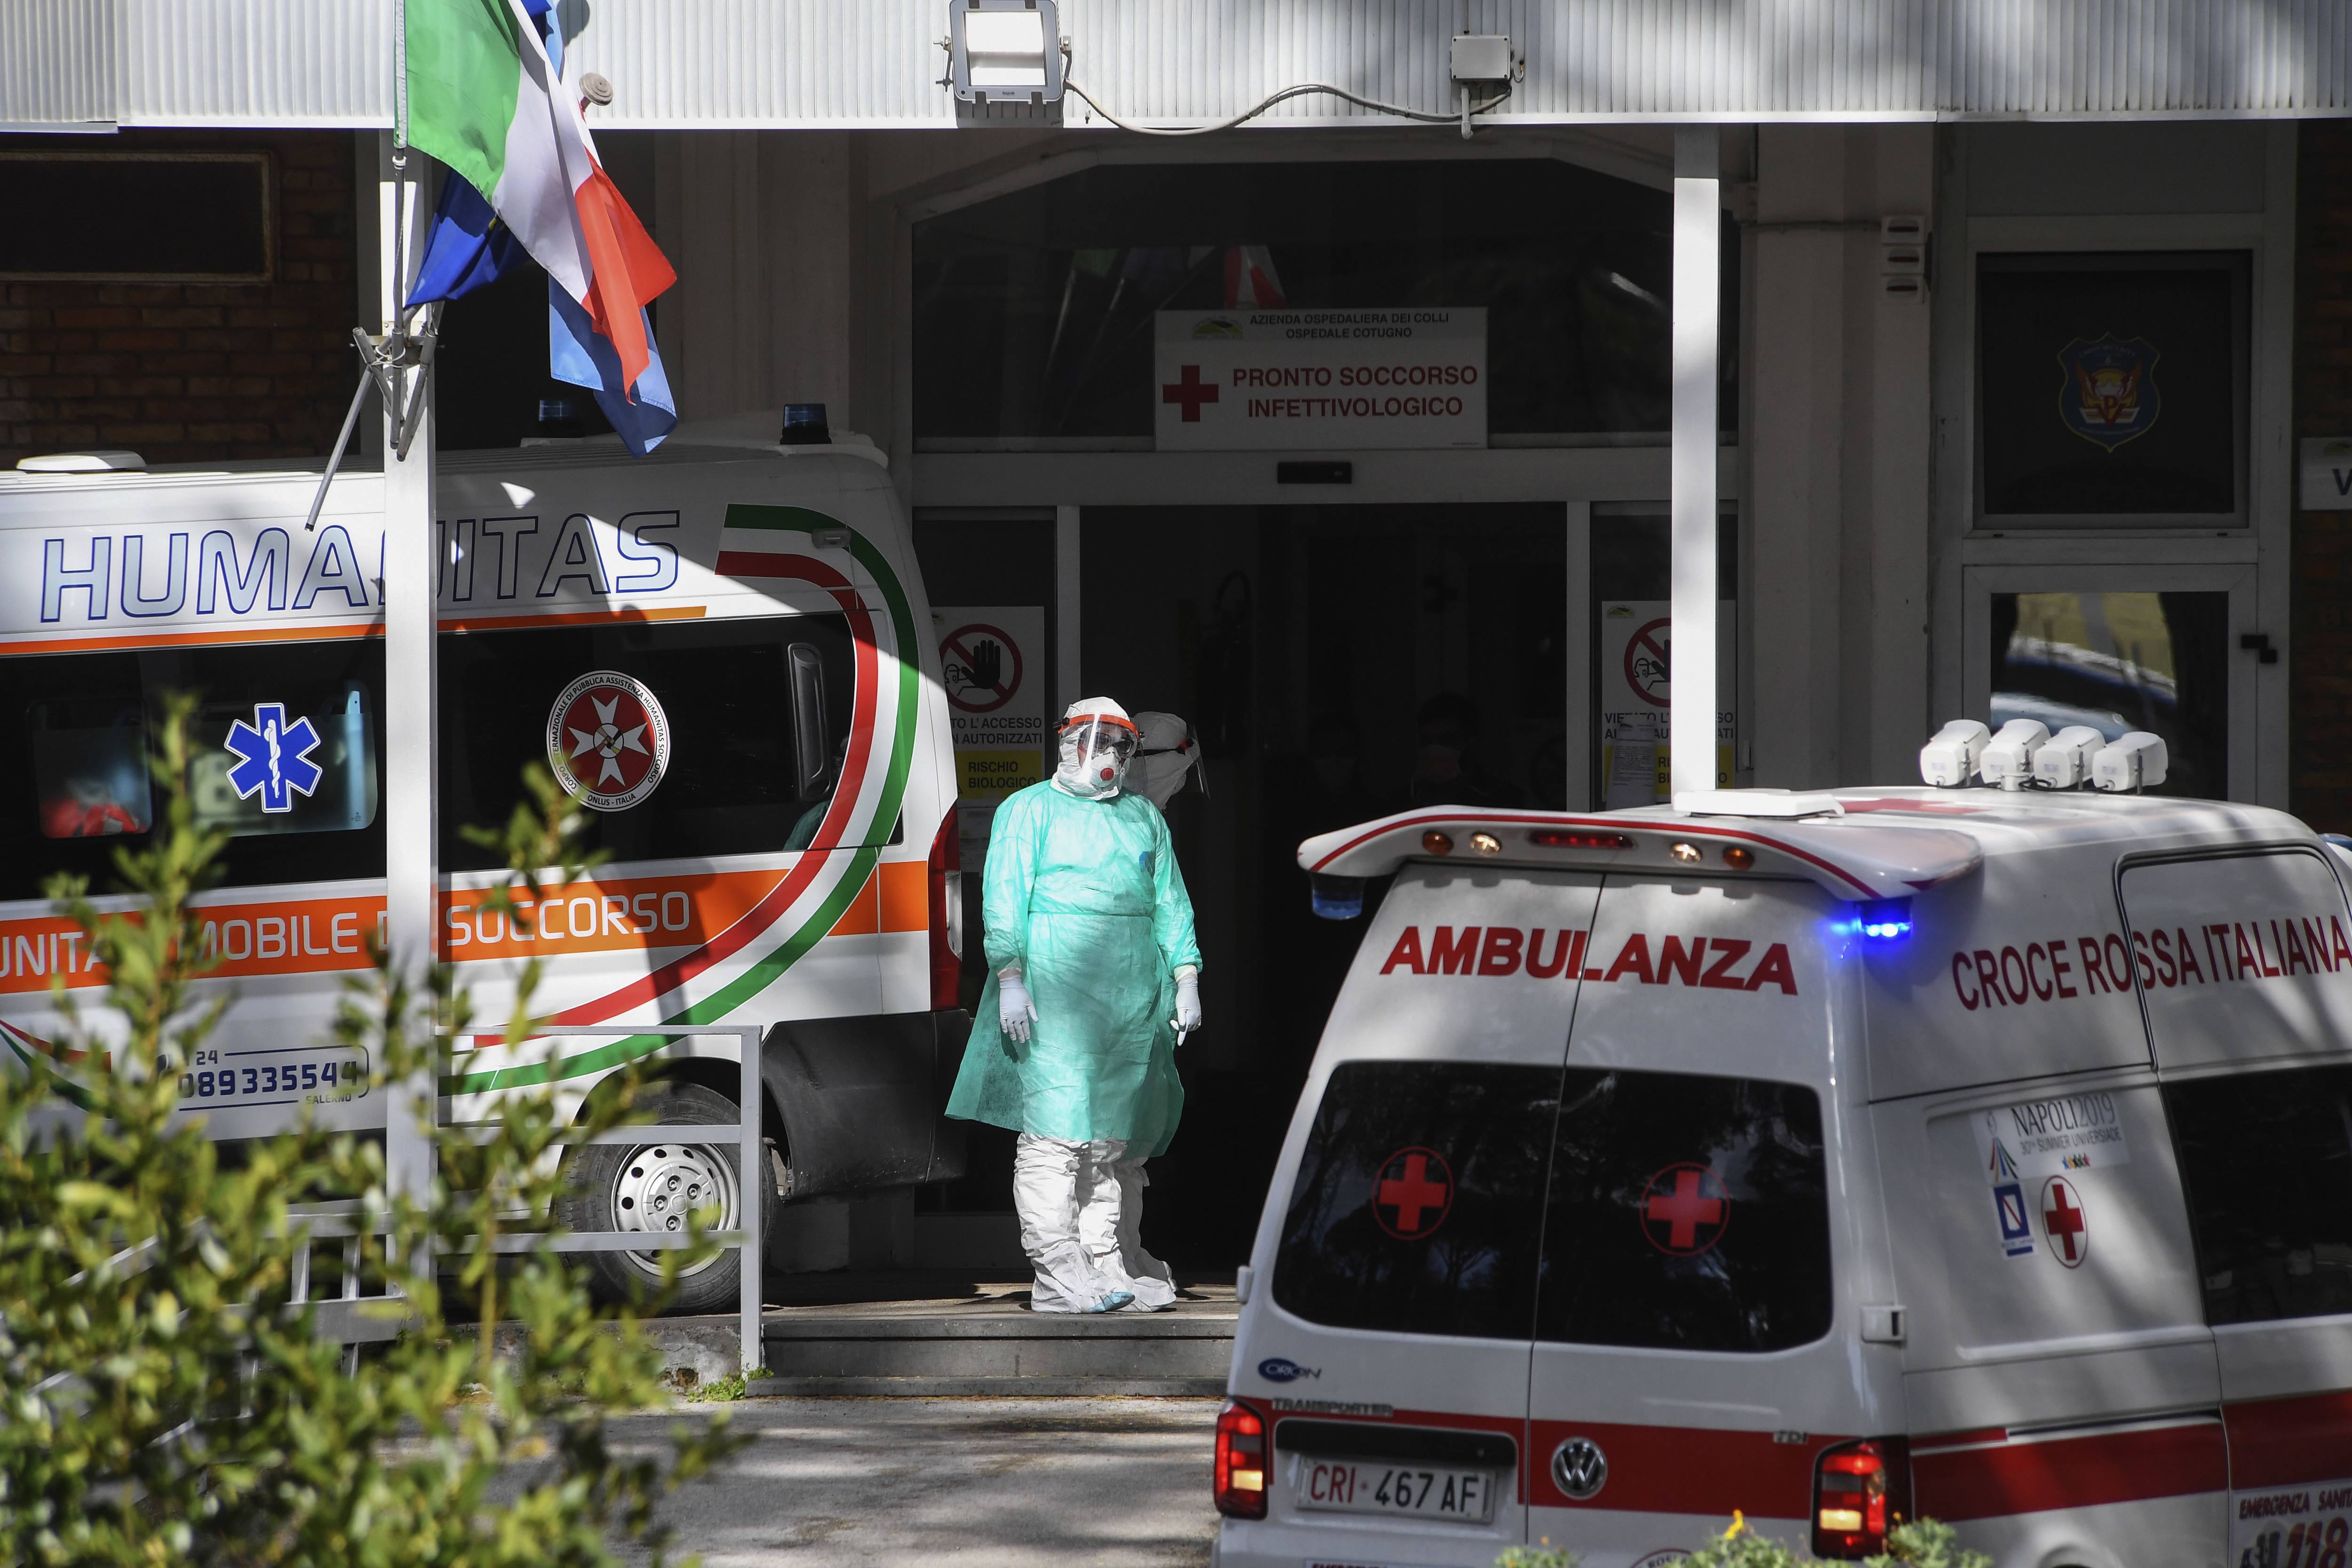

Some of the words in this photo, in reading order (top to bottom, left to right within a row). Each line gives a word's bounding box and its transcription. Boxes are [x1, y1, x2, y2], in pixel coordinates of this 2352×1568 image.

[1250, 314, 1300, 325] AZIENDA
[1304, 314, 1388, 324] OSPEDALIERA
[1391, 313, 1411, 323] DEI
[1414, 312, 1449, 323] COLLI
[1286, 328, 1349, 338] OSPEDALE
[1353, 327, 1412, 338] COTUGNO
[1232, 367, 1332, 387] PRONTO
[1339, 365, 1478, 386] SOCCORSO
[1248, 397, 1463, 417] INFETTIVOLOGICO
[40, 509, 680, 623] HUMAITAS
[565, 691, 574, 701] DI
[572, 676, 604, 695] PUBBLICA
[605, 676, 644, 699] ASSISTENZA
[643, 697, 665, 742] HUMANITAS
[1605, 712, 1656, 724] VIEO
[962, 733, 1042, 744] AUTORIZZATI
[647, 744, 665, 784] SOCCORSO
[968, 761, 1018, 773] RISCHIO
[559, 766, 577, 789] CORPO
[968, 777, 1036, 788] BIOLOGICO
[587, 794, 610, 806] ONLUS
[615, 793, 636, 806] ITALIA
[446, 891, 690, 946] SOCCORSO
[177, 912, 358, 962] MOBILE
[1379, 925, 1798, 995] AMBULANZA
[1951, 939, 2078, 1011] CROCE
[2078, 926, 2205, 996] ROSSA
[2202, 915, 2352, 983] ITALIANA
[196, 1050, 218, 1066] 24
[1271, 1397, 1394, 1417] TRANSPORTER
[1310, 1465, 1356, 1504] CRI
[1375, 1469, 1435, 1509] 467
[1440, 1472, 1480, 1513] AF
[2239, 1491, 2311, 1520] EMERGENZA
[2287, 1516, 2349, 1568] 118
